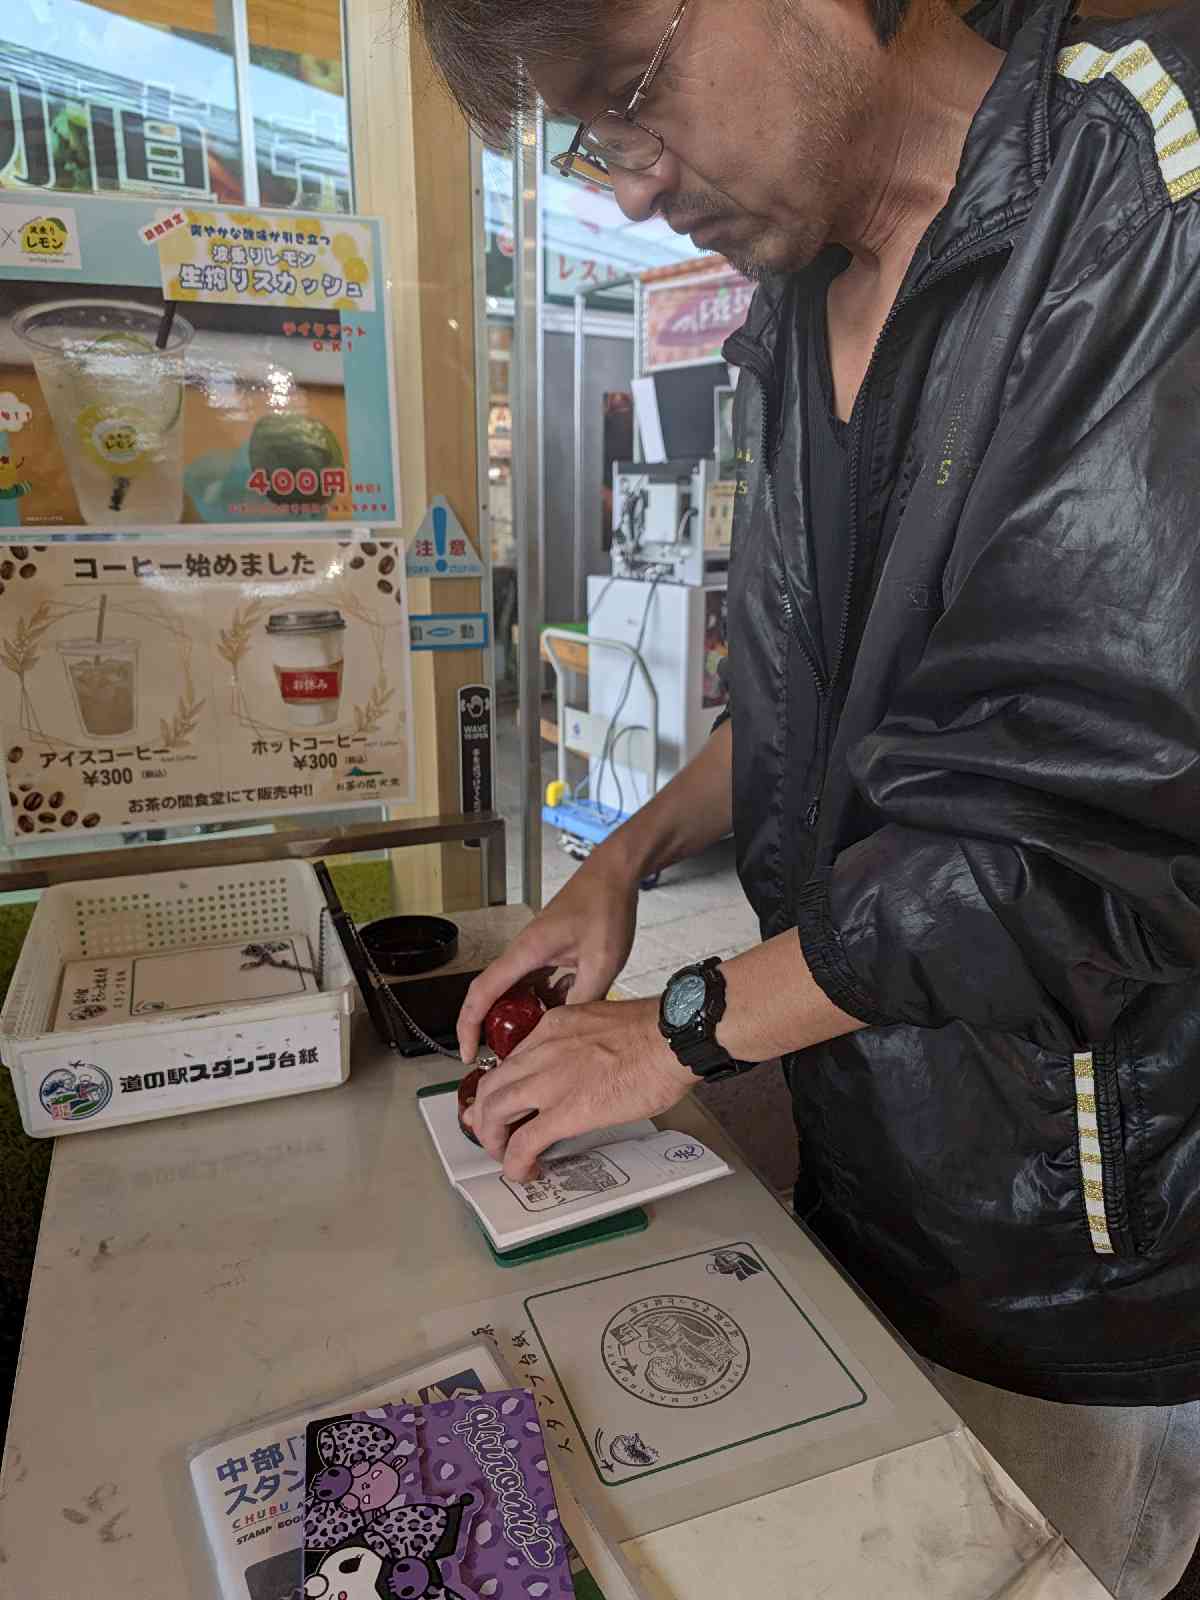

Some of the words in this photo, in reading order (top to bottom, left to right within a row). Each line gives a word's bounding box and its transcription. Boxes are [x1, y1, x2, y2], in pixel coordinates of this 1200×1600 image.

[26, 235, 64, 250] レモン
[178, 263, 364, 298] 生搾りスカッシュ
[248, 468, 348, 497] 400円
[73, 551, 316, 580] コーヒー始めました
[251, 734, 368, 756] ホットコーヒー
[39, 746, 171, 769] アイスコーヒー
[292, 752, 338, 771] ¥300
[82, 767, 133, 788] ¥300
[119, 1046, 320, 1094] 道の駅スタンプ台紙
[232, 1501, 289, 1530] CHUBU
[236, 1525, 273, 1545] STAMP
